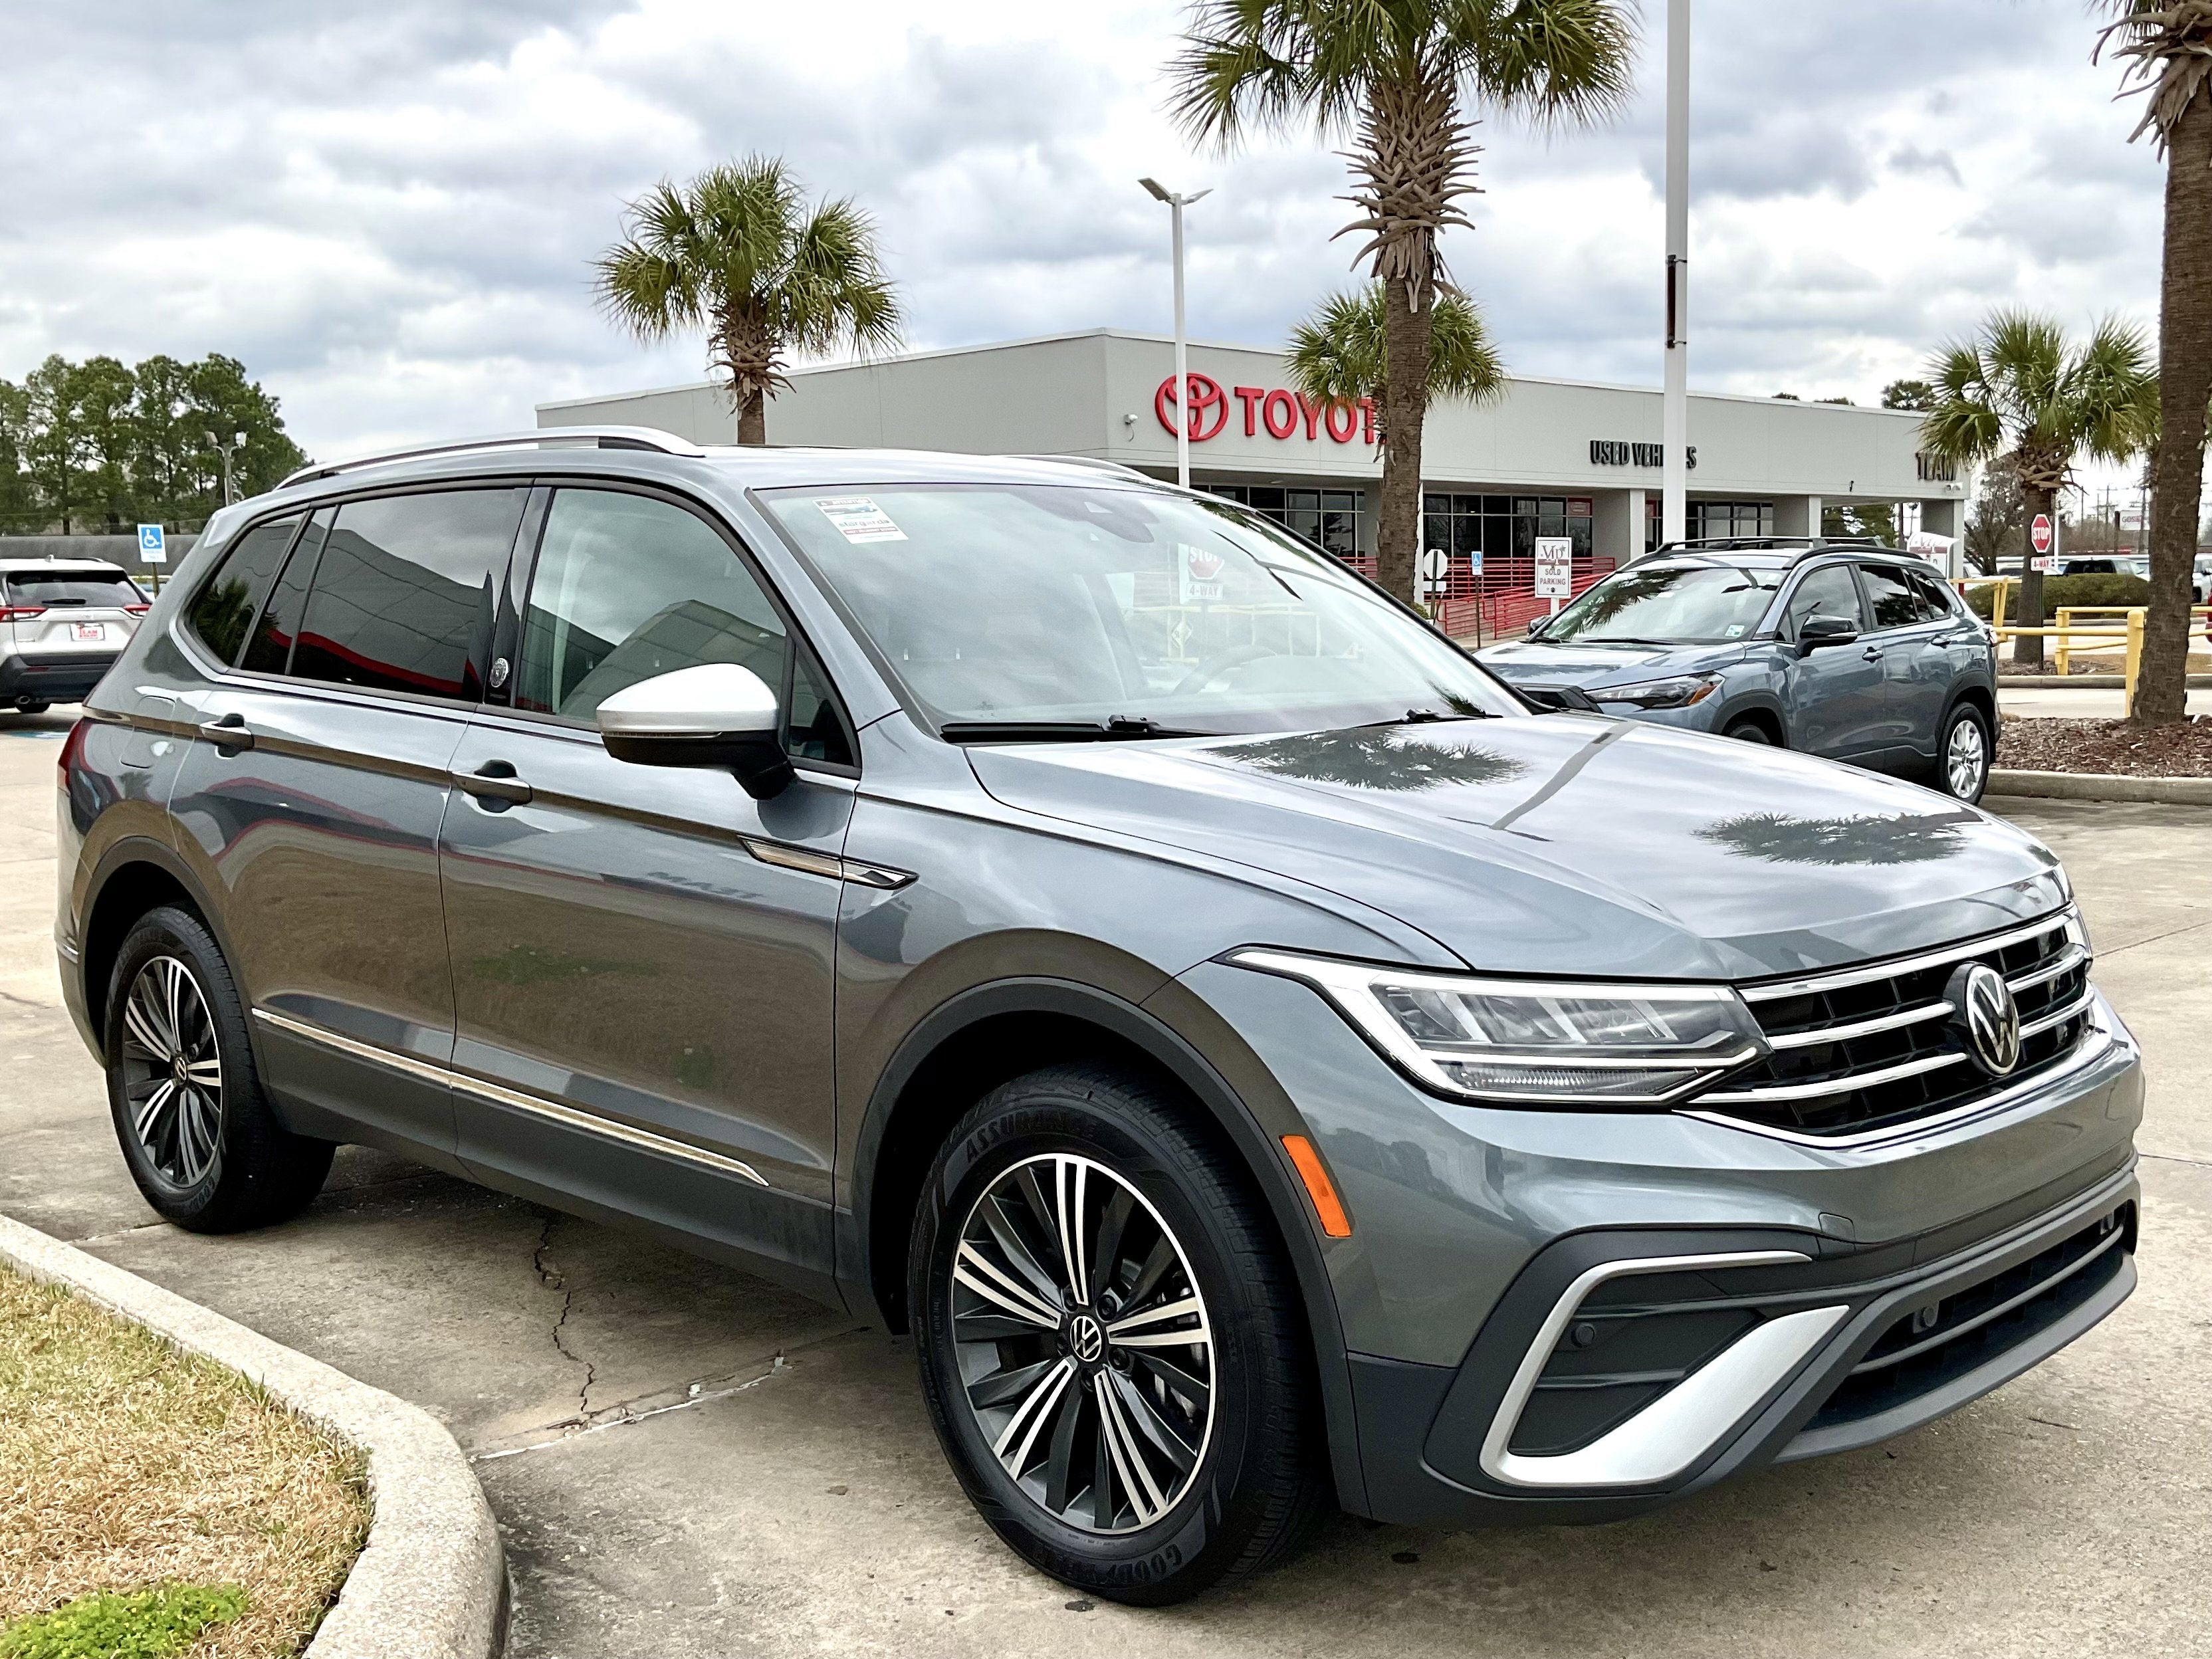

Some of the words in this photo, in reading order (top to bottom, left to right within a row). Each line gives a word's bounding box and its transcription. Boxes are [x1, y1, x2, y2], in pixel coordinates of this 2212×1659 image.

[1234, 386, 1387, 444] TOYOT
[1590, 440, 1630, 465] USED
[1632, 443, 1697, 469] VEHS
[2033, 526, 2050, 540] STOP
[1189, 585, 1218, 597] 4-WAY
